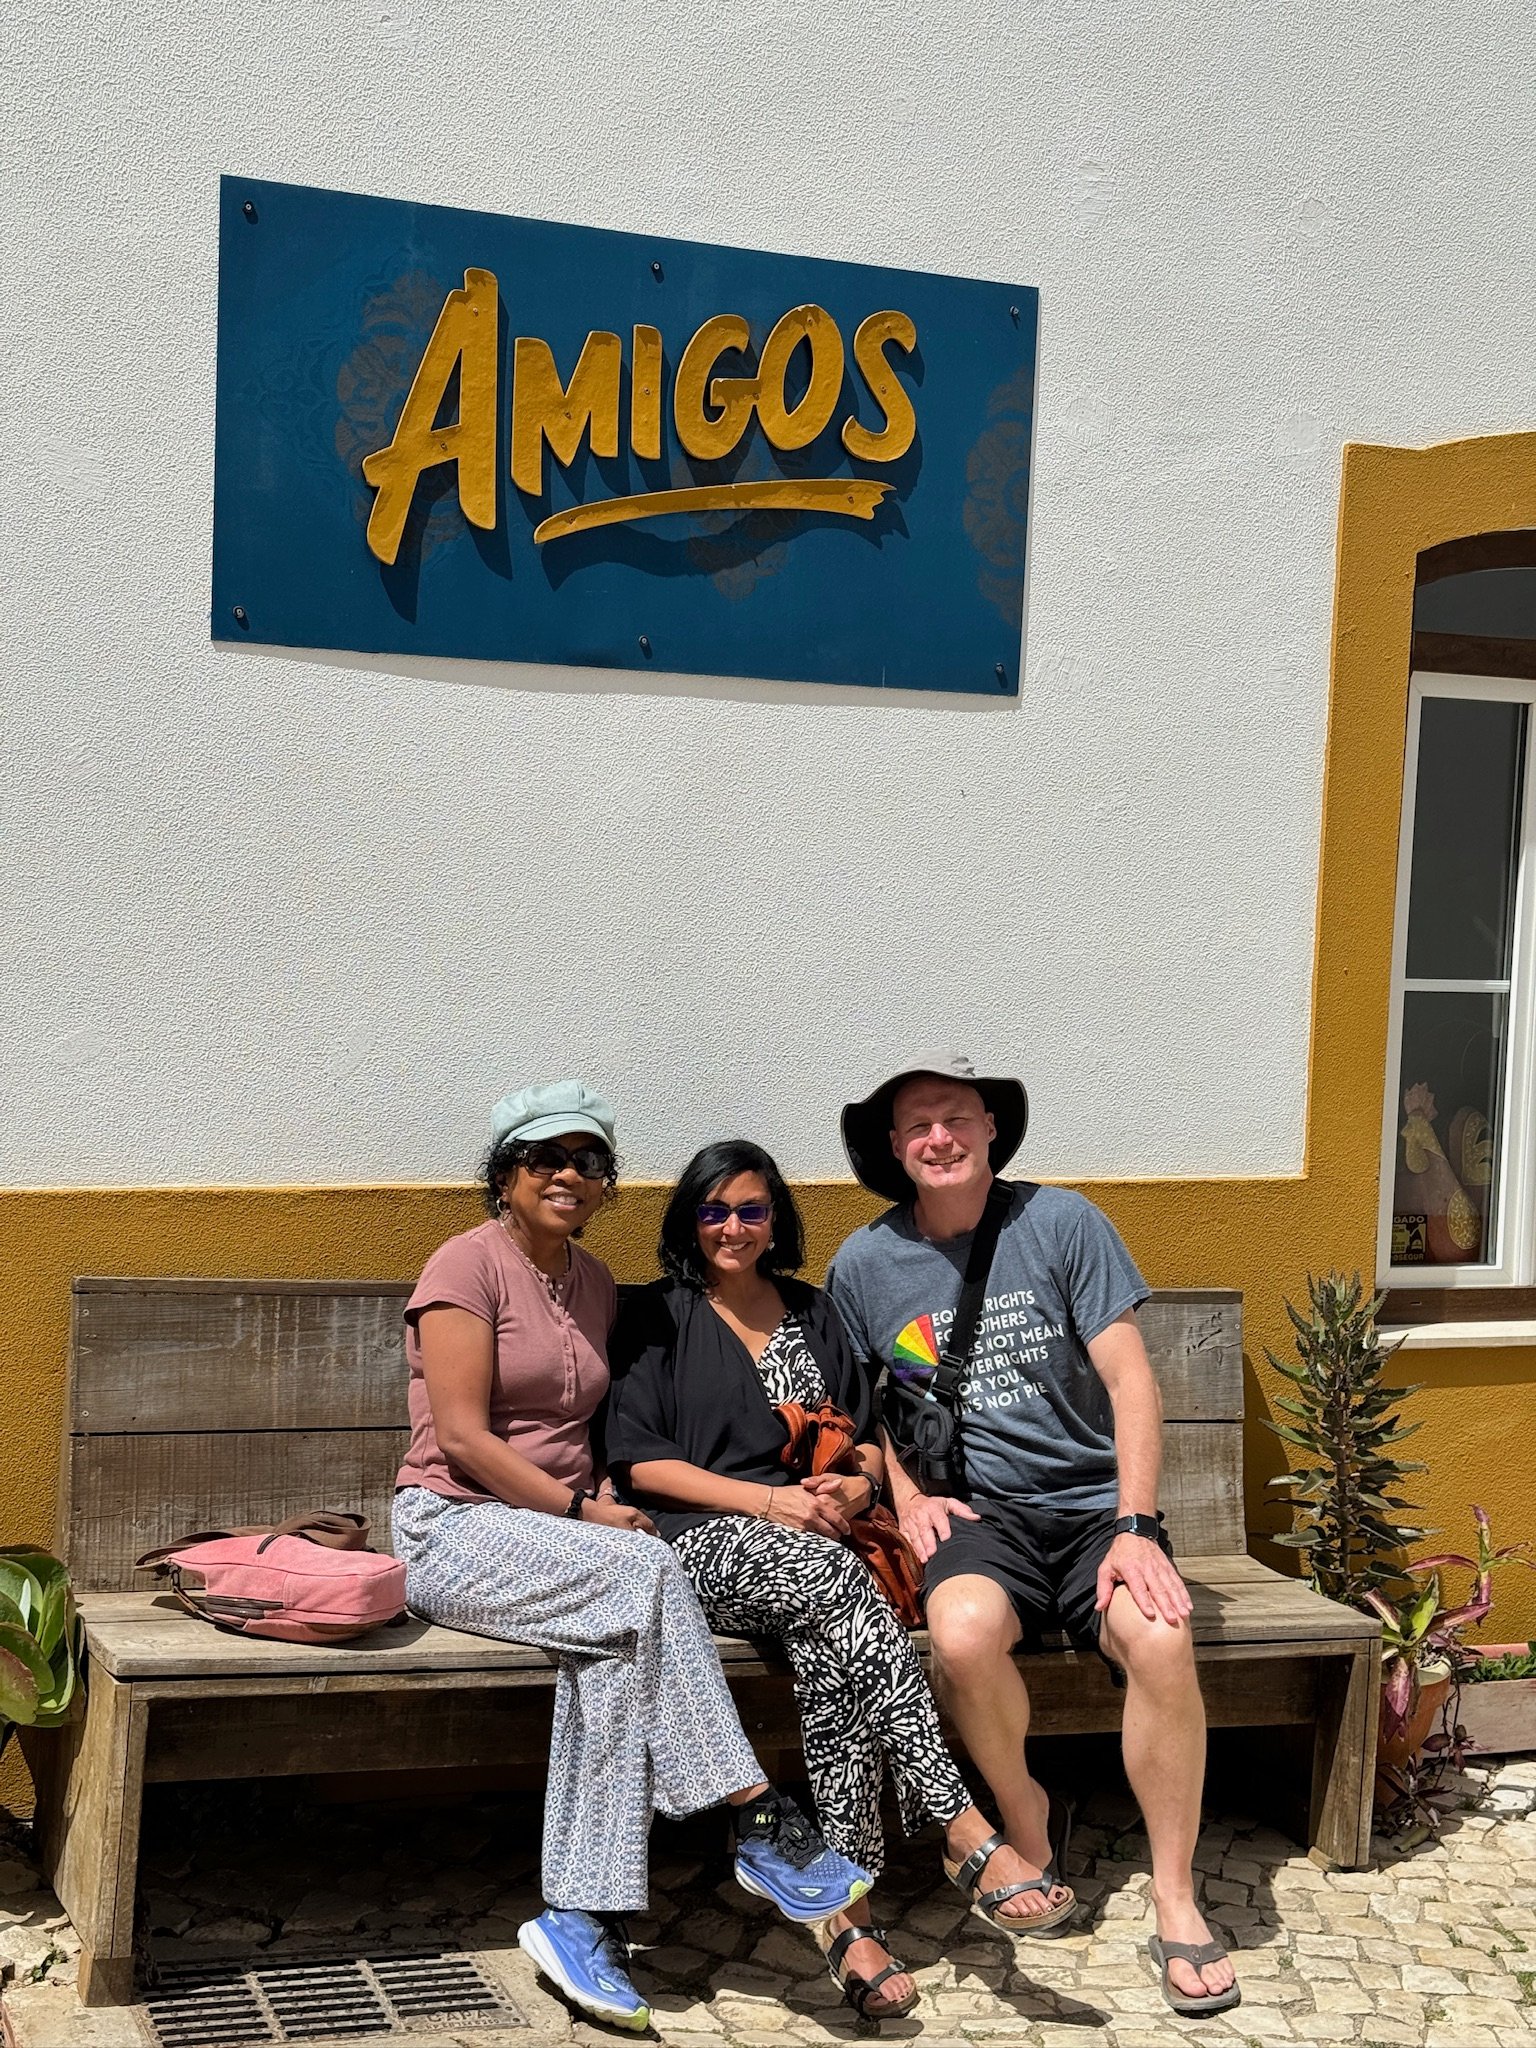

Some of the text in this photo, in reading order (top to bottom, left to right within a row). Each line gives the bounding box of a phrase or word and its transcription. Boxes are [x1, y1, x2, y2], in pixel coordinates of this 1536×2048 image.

[362, 267, 918, 566] AMIGOS
[1393, 1215, 1425, 1224] GADO
[1392, 1253, 1424, 1261] OSEGUR
[985, 1289, 1035, 1312] RIGHTS
[974, 1311, 1028, 1335] OTHERS
[986, 1333, 1015, 1352] NOT
[1020, 1324, 1065, 1345] MEAN
[994, 1345, 1049, 1369] RIGHTS
[958, 1369, 1025, 1397] OR YOU.
[985, 1388, 1021, 1408] NOT
